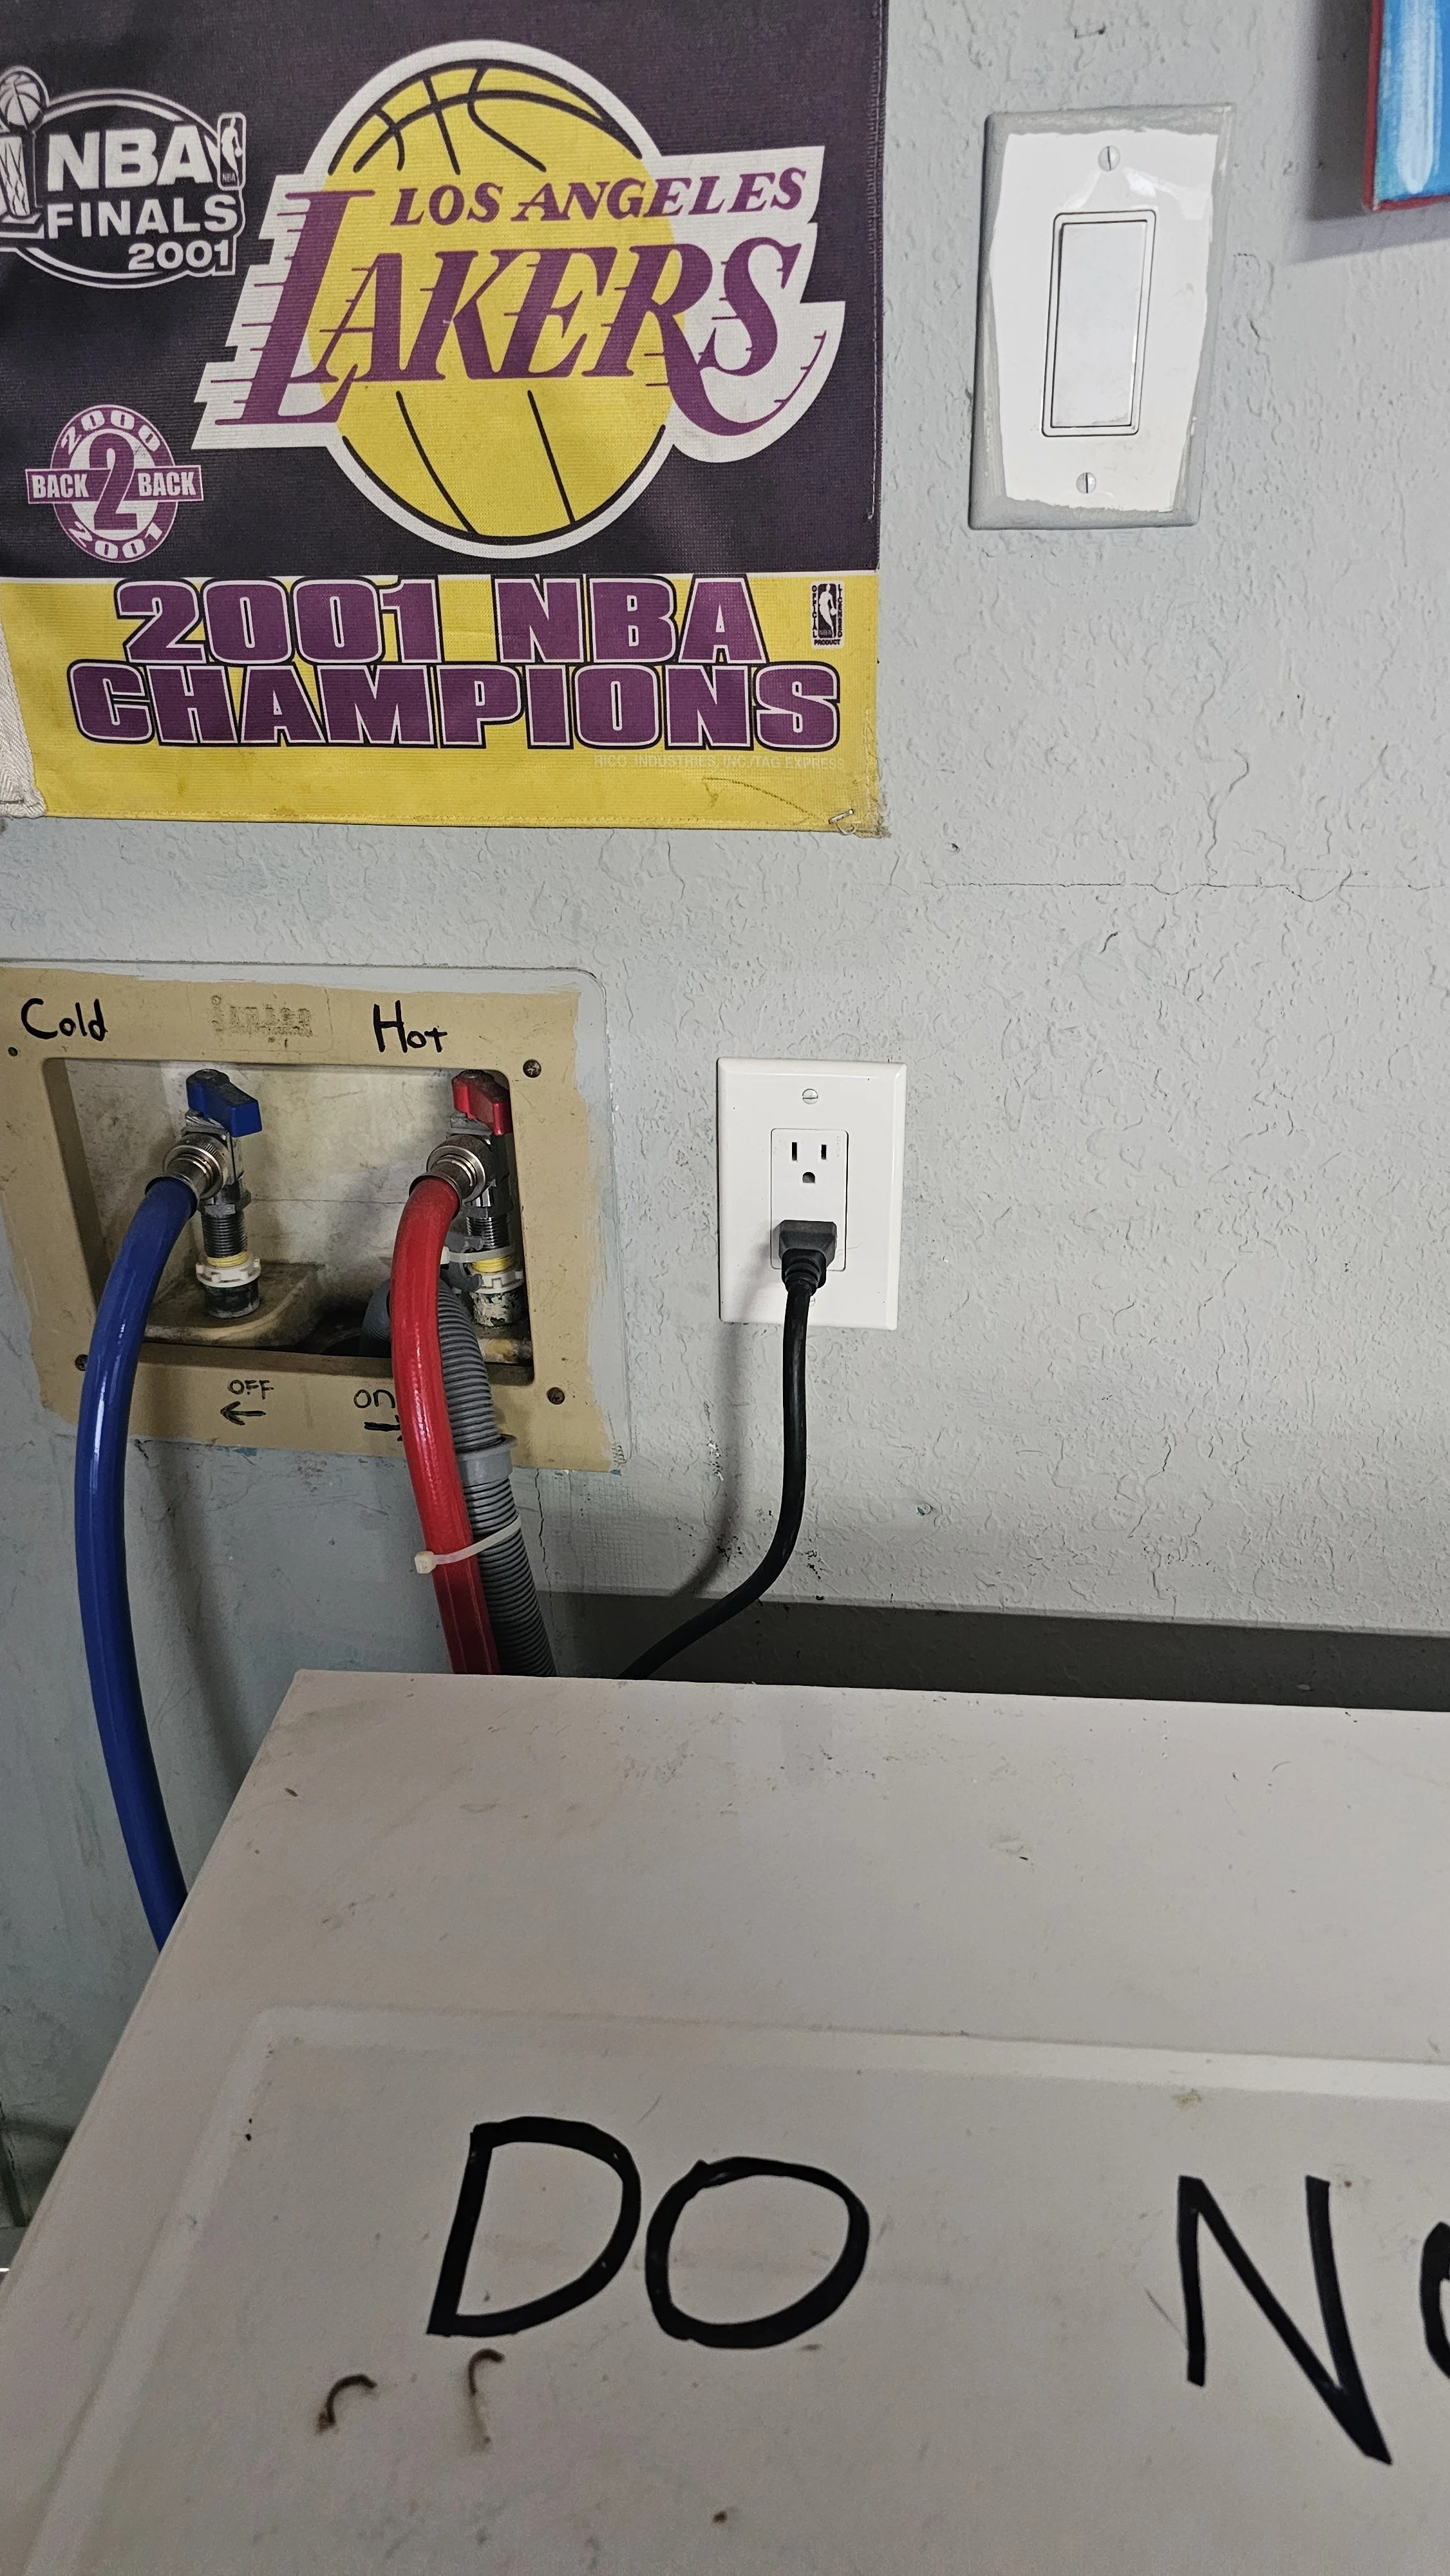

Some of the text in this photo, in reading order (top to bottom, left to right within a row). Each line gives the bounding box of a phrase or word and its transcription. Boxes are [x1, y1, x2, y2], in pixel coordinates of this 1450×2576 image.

[47, 125, 215, 192] NBA
[47, 194, 238, 239] FINALS
[391, 167, 806, 225] LOS ANGELES
[128, 240, 231, 271] 2001
[214, 189, 827, 437] LAKERS
[61, 410, 161, 455] 2000
[32, 432, 196, 530] BACK 2 BACK
[69, 521, 162, 559] 2001
[114, 573, 770, 664] 2001 NBA
[68, 659, 840, 752] CHAMPIONS
[594, 754, 627, 767] RICO
[786, 756, 845, 770] EXPRESS
[21, 998, 108, 1041] Cold
[373, 1000, 447, 1053] Hot
[228, 1379, 274, 1400] OFF
[426, 2116, 1450, 2466] DO N
